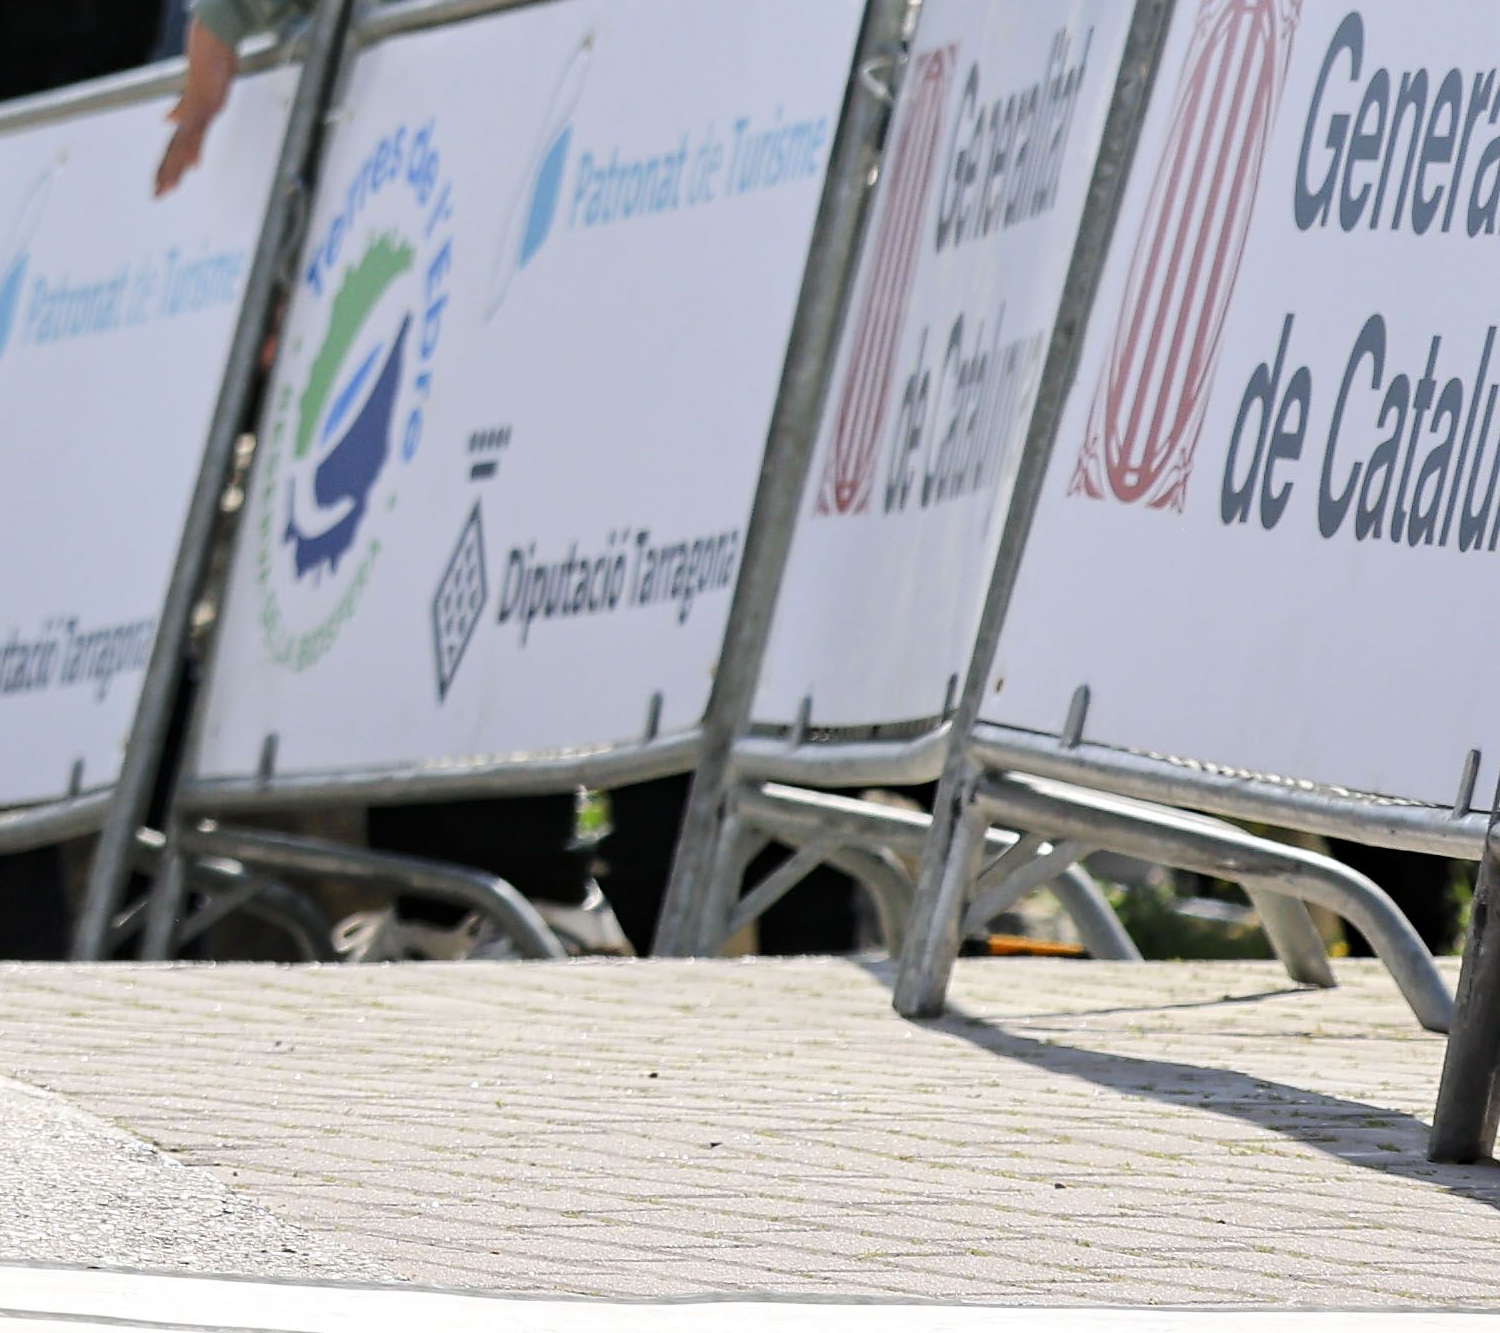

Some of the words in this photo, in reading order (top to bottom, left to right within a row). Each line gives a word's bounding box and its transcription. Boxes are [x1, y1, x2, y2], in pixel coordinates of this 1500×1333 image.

[1294, 11, 1500, 238] Genera
[1220, 312, 1313, 530] de
[1317, 313, 1500, 554] Catalu
[497, 525, 627, 650] Diputació
